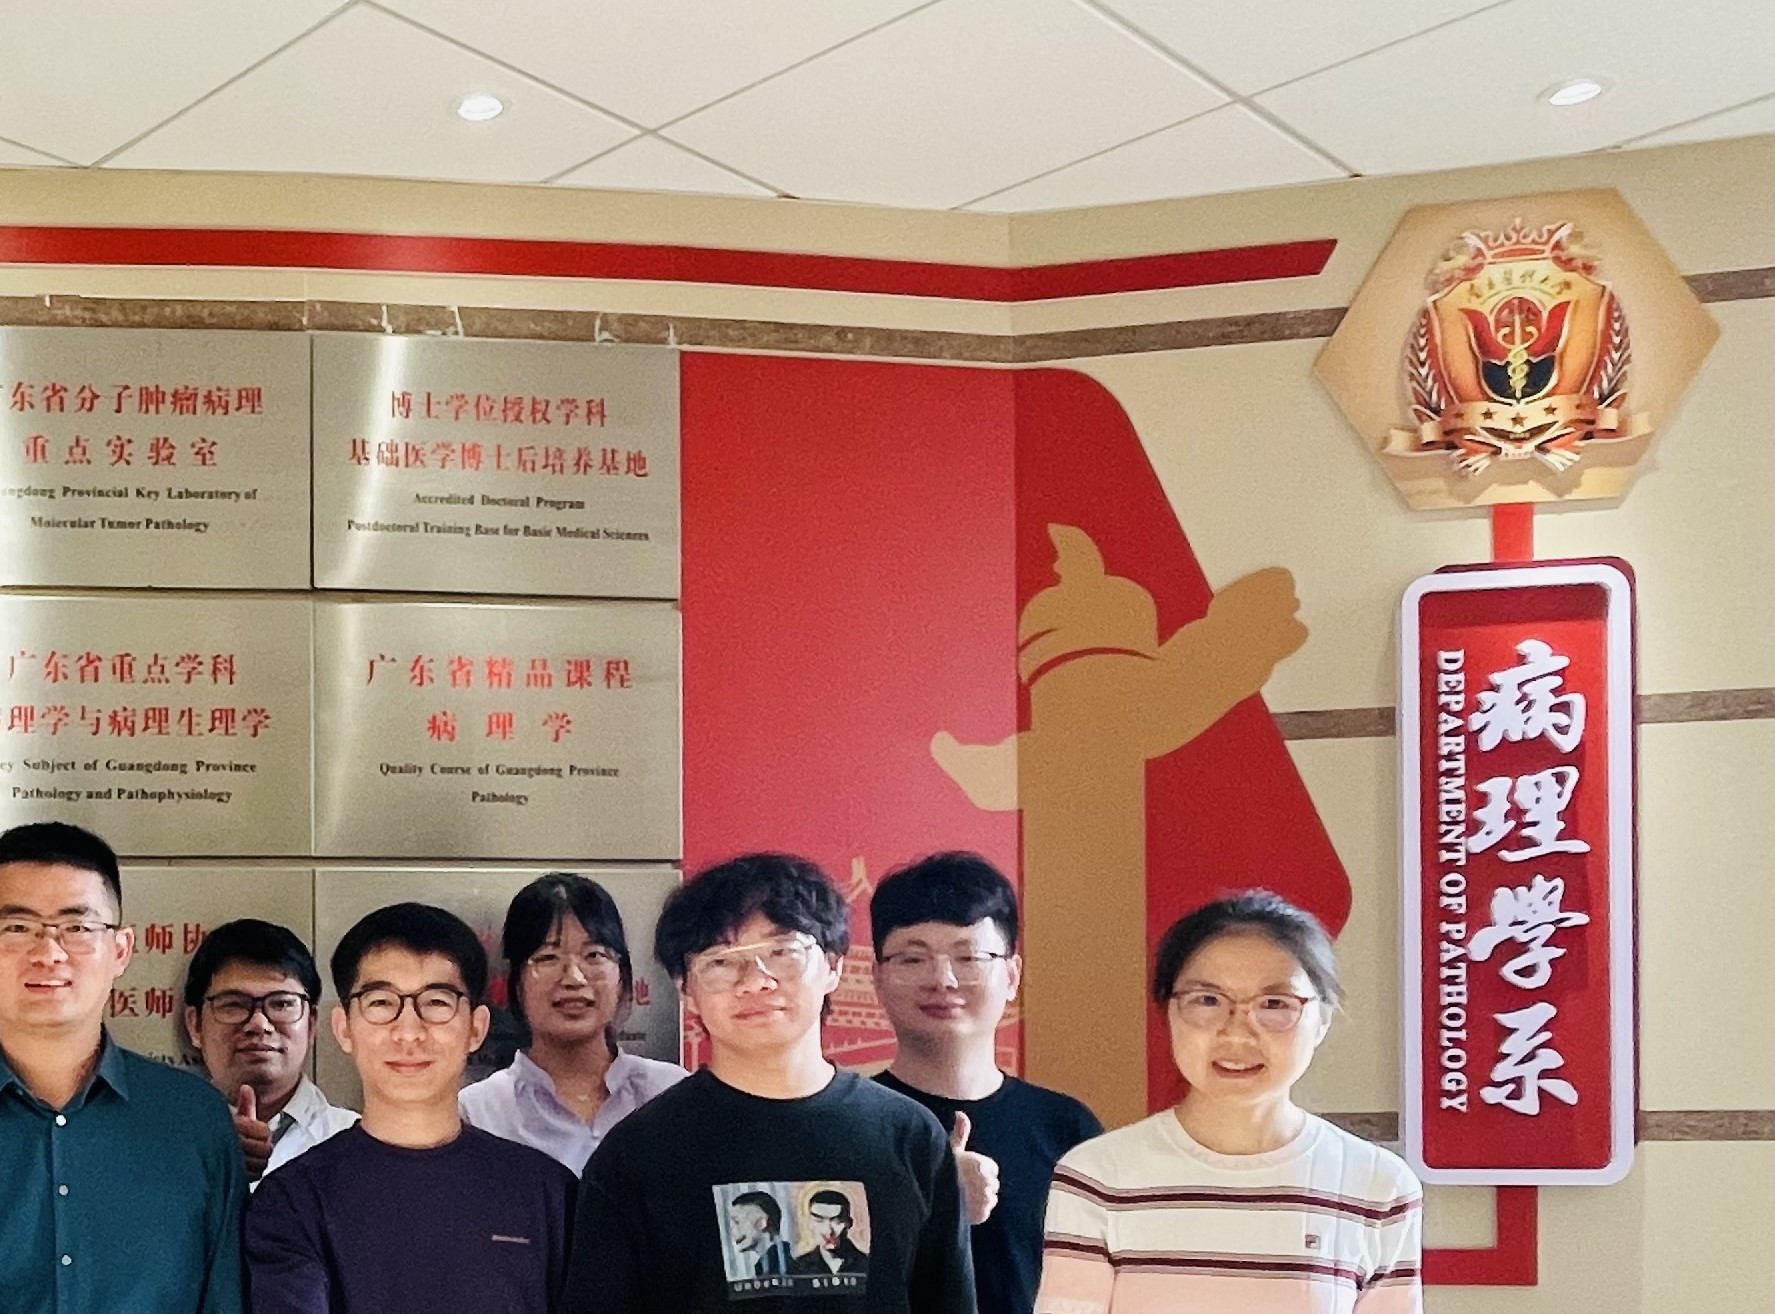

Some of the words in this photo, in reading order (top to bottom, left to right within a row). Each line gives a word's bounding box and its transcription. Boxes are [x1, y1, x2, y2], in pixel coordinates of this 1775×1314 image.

[391, 390, 607, 427] 博士学位授权学科
[23, 433, 219, 467] 重点实验室
[348, 437, 649, 478] 基础医学博士后培养基地
[62, 485, 128, 498] Provincial
[135, 487, 160, 502] Key
[167, 487, 241, 503] Laboratory
[244, 488, 258, 501] of
[415, 493, 474, 506] Accredited
[481, 494, 530, 508] Doctoral
[536, 496, 585, 511] Program
[100, 517, 141, 530] Tumor
[145, 518, 209, 533] Pathology
[347, 519, 419, 534] Postdoctoral
[423, 521, 471, 537] Training
[475, 523, 500, 536] Base
[503, 524, 520, 537] for
[524, 524, 552, 538] Basic
[556, 526, 600, 540] Medical
[603, 527, 650, 542] Sciences
[8, 650, 236, 685] 广东省重点学科
[367, 653, 633, 689] 广东省精品课程
[426, 710, 572, 743] 病理学
[23, 758, 75, 774] Subject
[83, 758, 99, 772] of
[105, 759, 188, 775] Guangdong
[195, 760, 257, 773] Province
[379, 763, 423, 778] Quality
[430, 763, 471, 775] Course
[477, 763, 489, 775] of
[495, 764, 563, 779] Guangdong
[569, 764, 620, 777] Province
[1437, 648, 1467, 866] DEPARTMENT
[12, 786, 81, 802] Pathology
[86, 787, 111, 800] and
[117, 787, 232, 804] Pathophysiology
[471, 790, 528, 805] Pathology
[1438, 872, 1467, 914] OF
[1438, 921, 1469, 1113] PATHOLOGY
